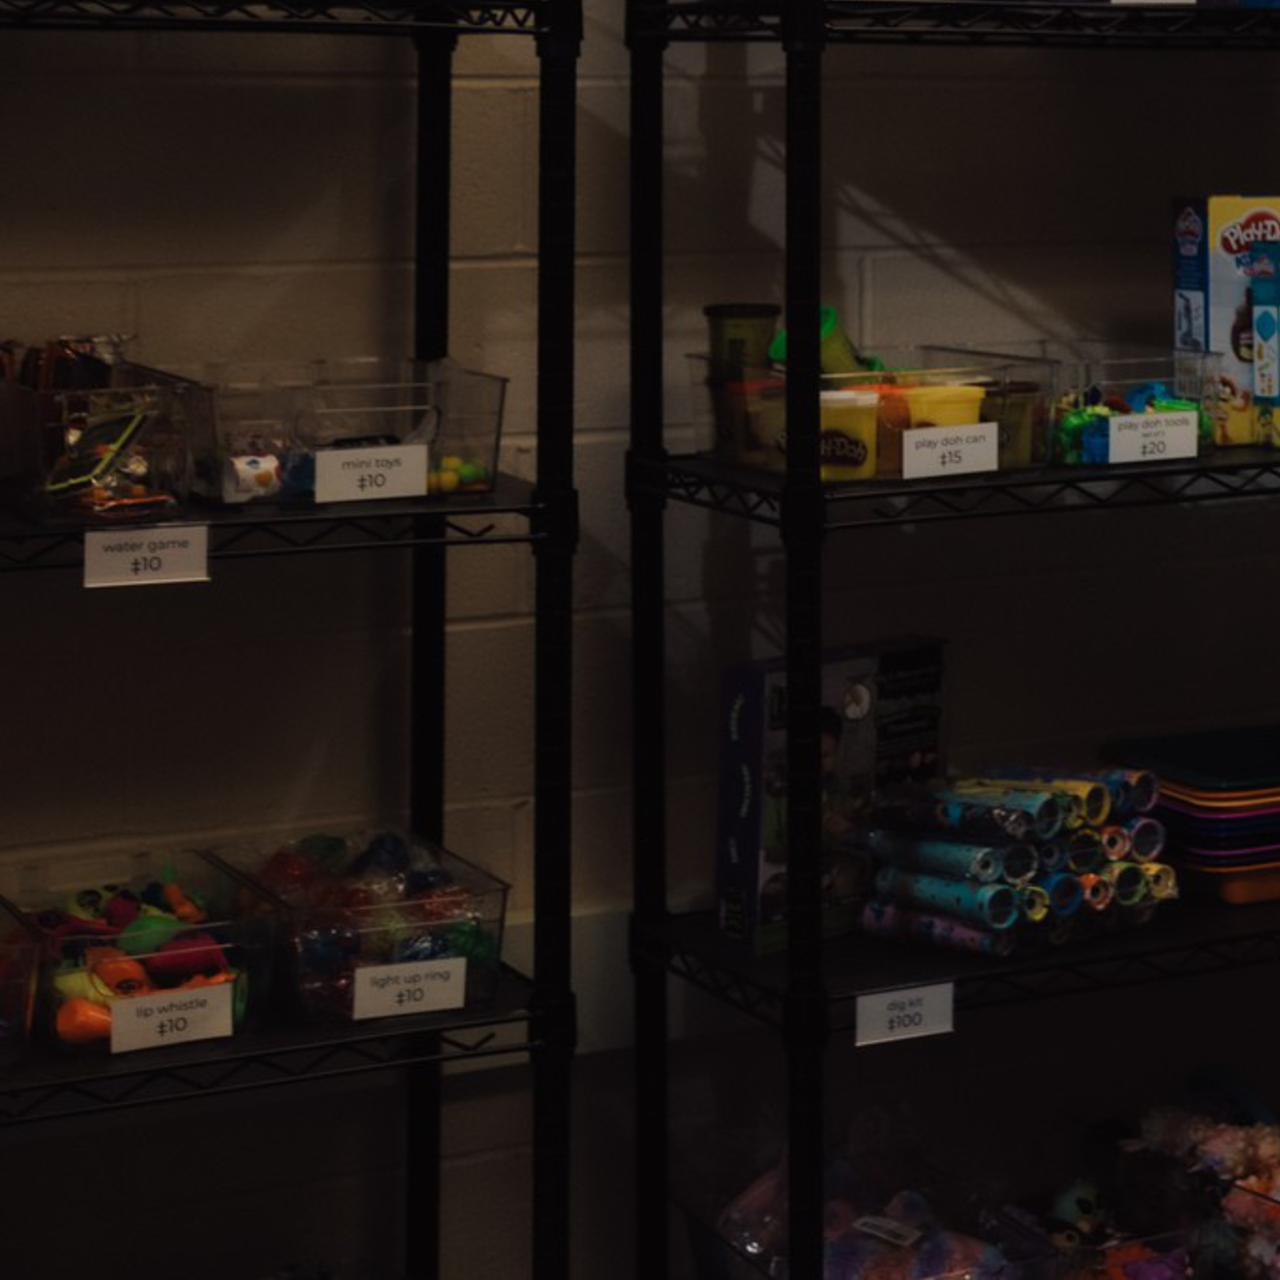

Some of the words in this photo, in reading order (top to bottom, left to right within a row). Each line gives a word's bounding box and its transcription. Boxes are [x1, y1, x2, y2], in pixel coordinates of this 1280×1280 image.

[1117, 421, 1140, 431] play
[1141, 419, 1163, 429] doh
[914, 439, 939, 451] play
[941, 437, 965, 448] doh
[966, 434, 986, 445] can
[341, 459, 373, 471] mini
[374, 457, 403, 470] toys
[102, 541, 144, 554] water
[146, 538, 190, 554] game
[370, 975, 402, 990] light
[404, 973, 422, 985] up
[424, 970, 450, 985] ring
[157, 997, 208, 1015] whistle
